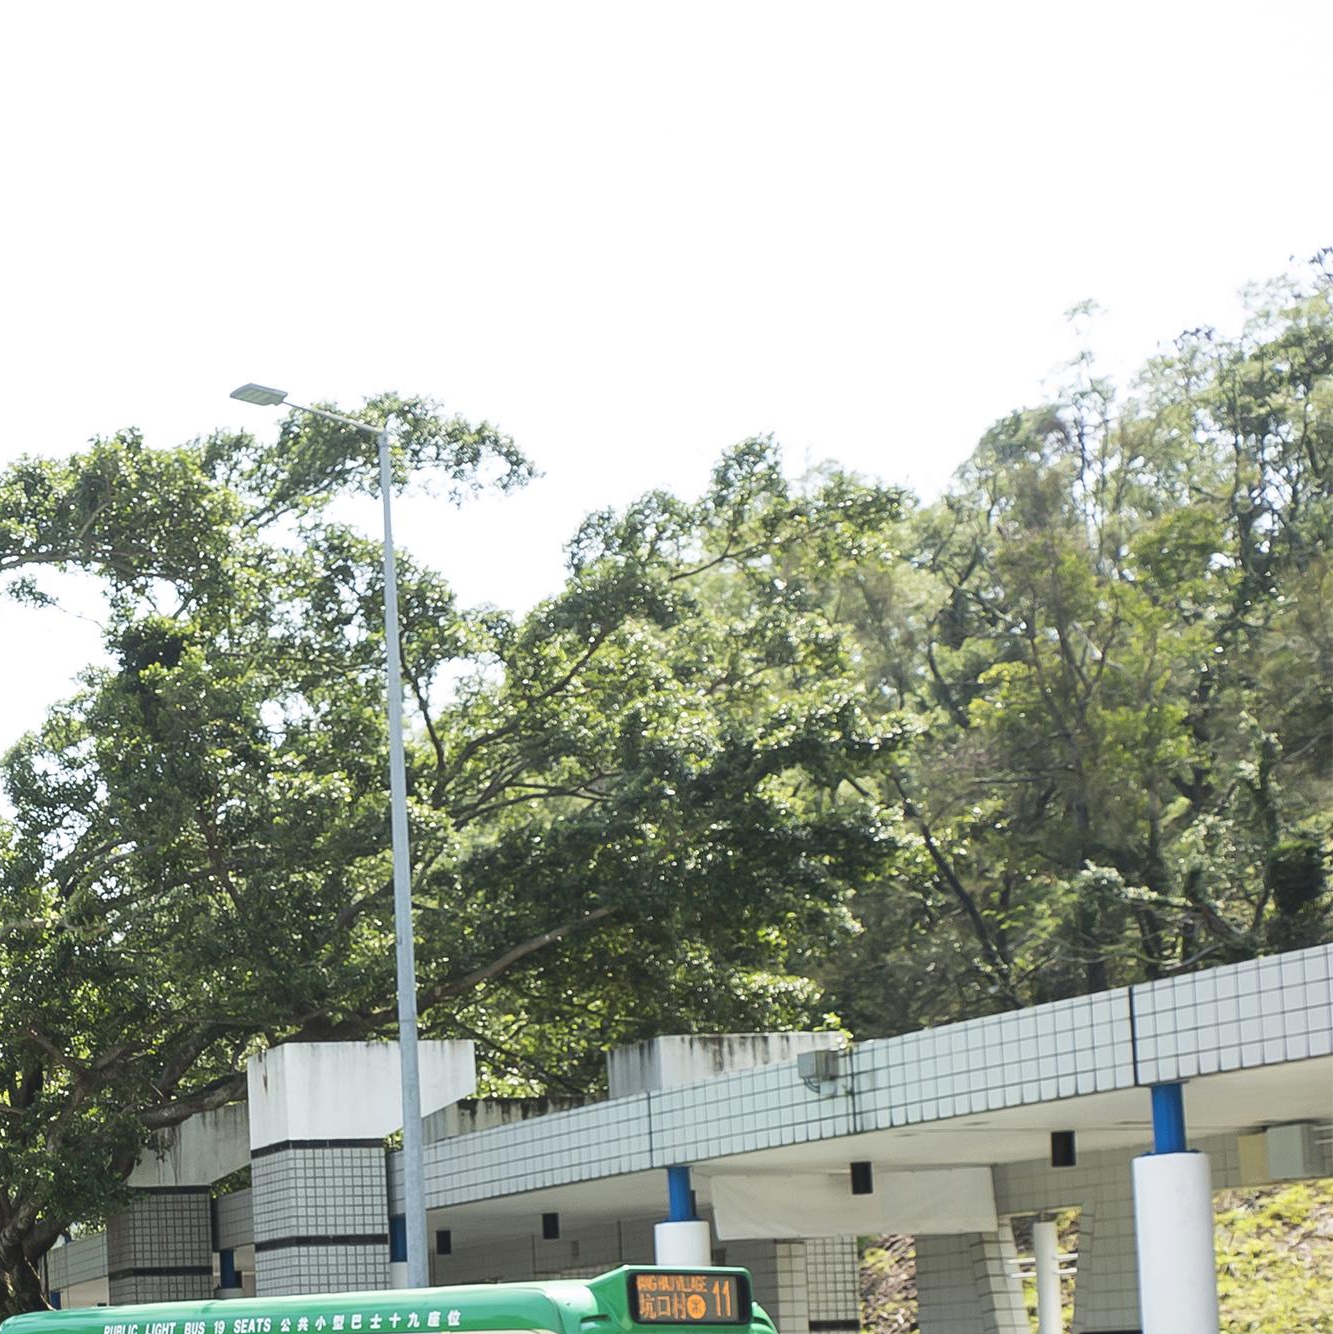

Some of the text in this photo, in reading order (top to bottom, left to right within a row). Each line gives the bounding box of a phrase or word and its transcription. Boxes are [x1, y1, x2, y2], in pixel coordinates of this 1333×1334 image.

[675, 1275, 708, 1293] VILLAGE
[712, 1279, 731, 1317] 11
[233, 1317, 272, 1334] SEATS
[280, 1309, 461, 1333] 公共小型巴士十九座位
